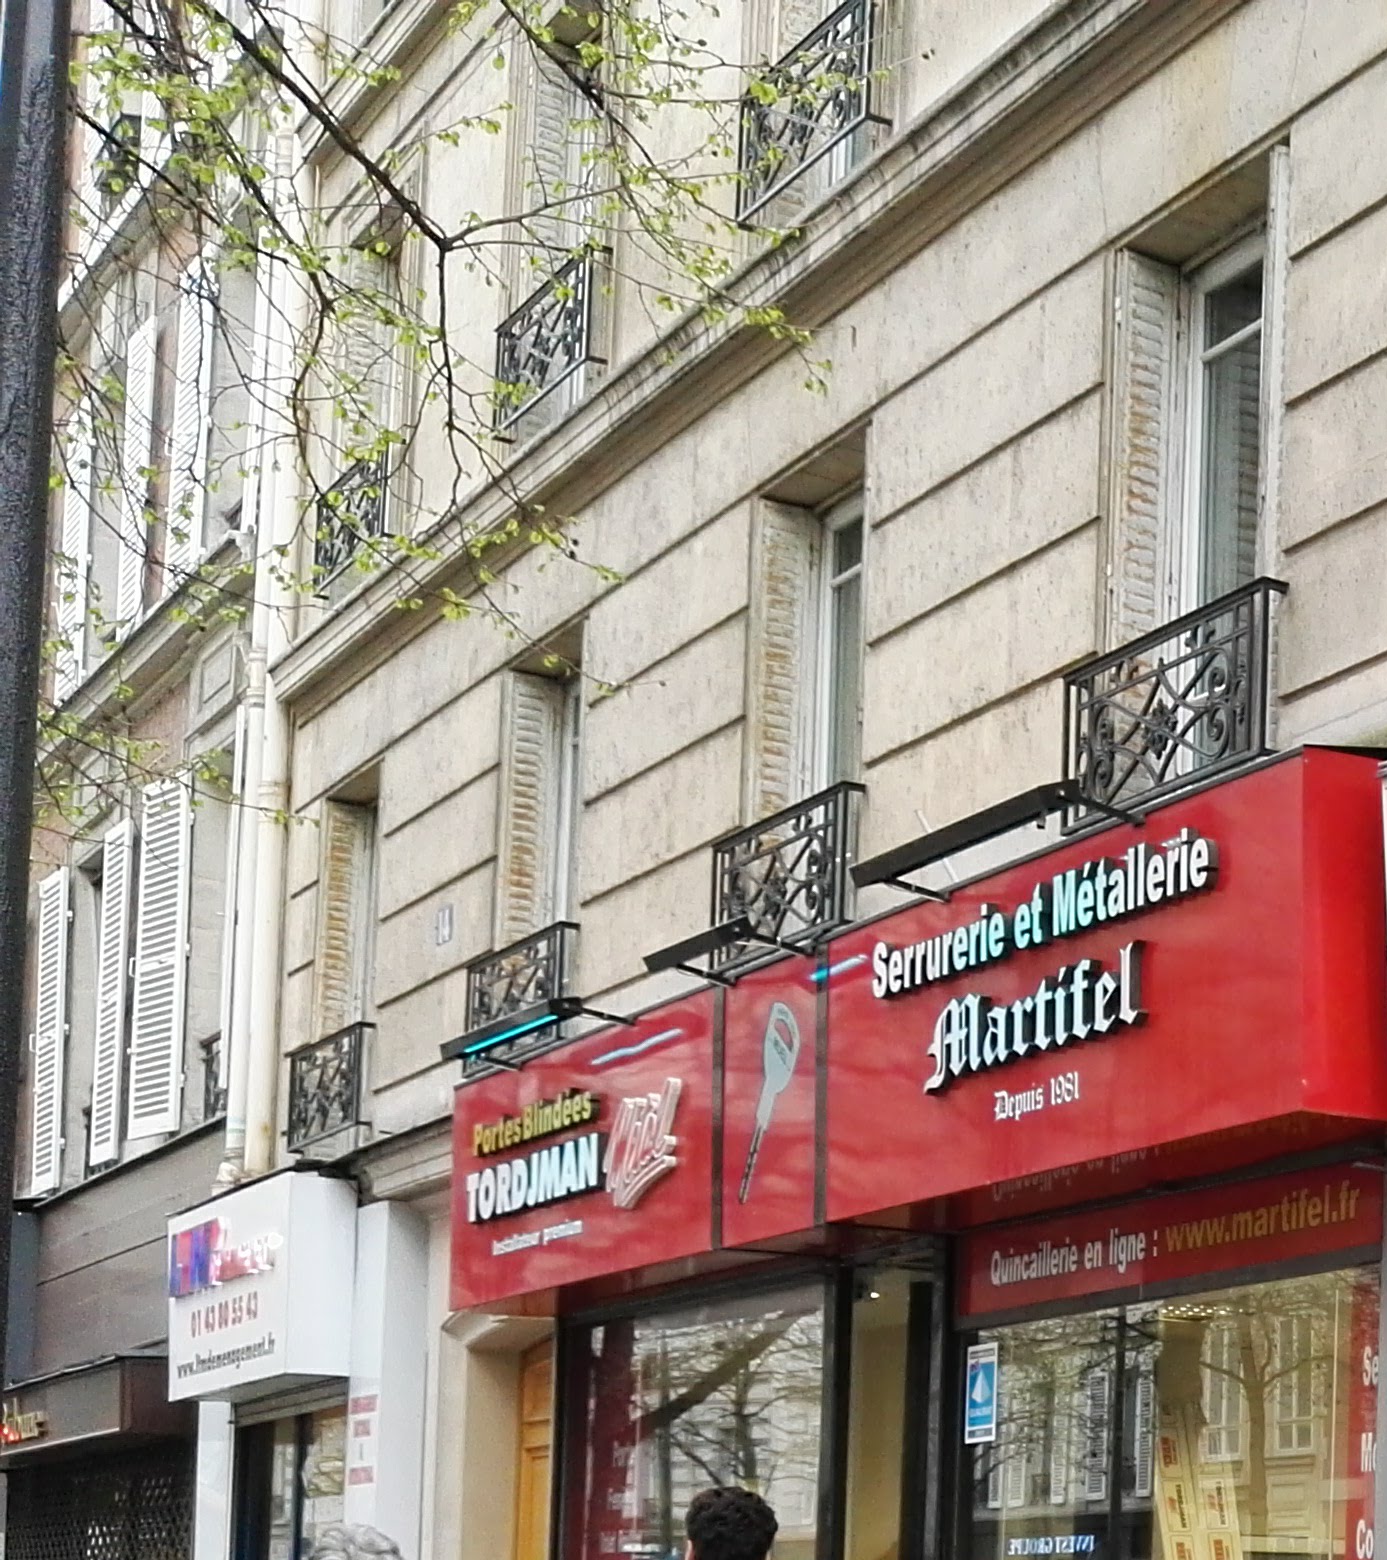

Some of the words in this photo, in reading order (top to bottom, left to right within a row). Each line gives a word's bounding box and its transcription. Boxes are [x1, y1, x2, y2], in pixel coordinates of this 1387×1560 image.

[872, 903, 1005, 999] Serrurerie
[1013, 883, 1043, 950] et
[1052, 827, 1212, 937] Métallerie
[923, 941, 1140, 1095] Martifel
[472, 1114, 521, 1157] Portes
[521, 1088, 593, 1141] Blindées
[993, 1081, 1044, 1121] Depuis
[1050, 1071, 1080, 1106] 1981
[466, 1131, 600, 1223] TORDJMAN
[990, 1237, 1078, 1287] Quincaillerie
[1084, 1246, 1102, 1270] en
[1109, 1228, 1147, 1274] ligne
[1165, 1179, 1361, 1253] www.martifel.fr
